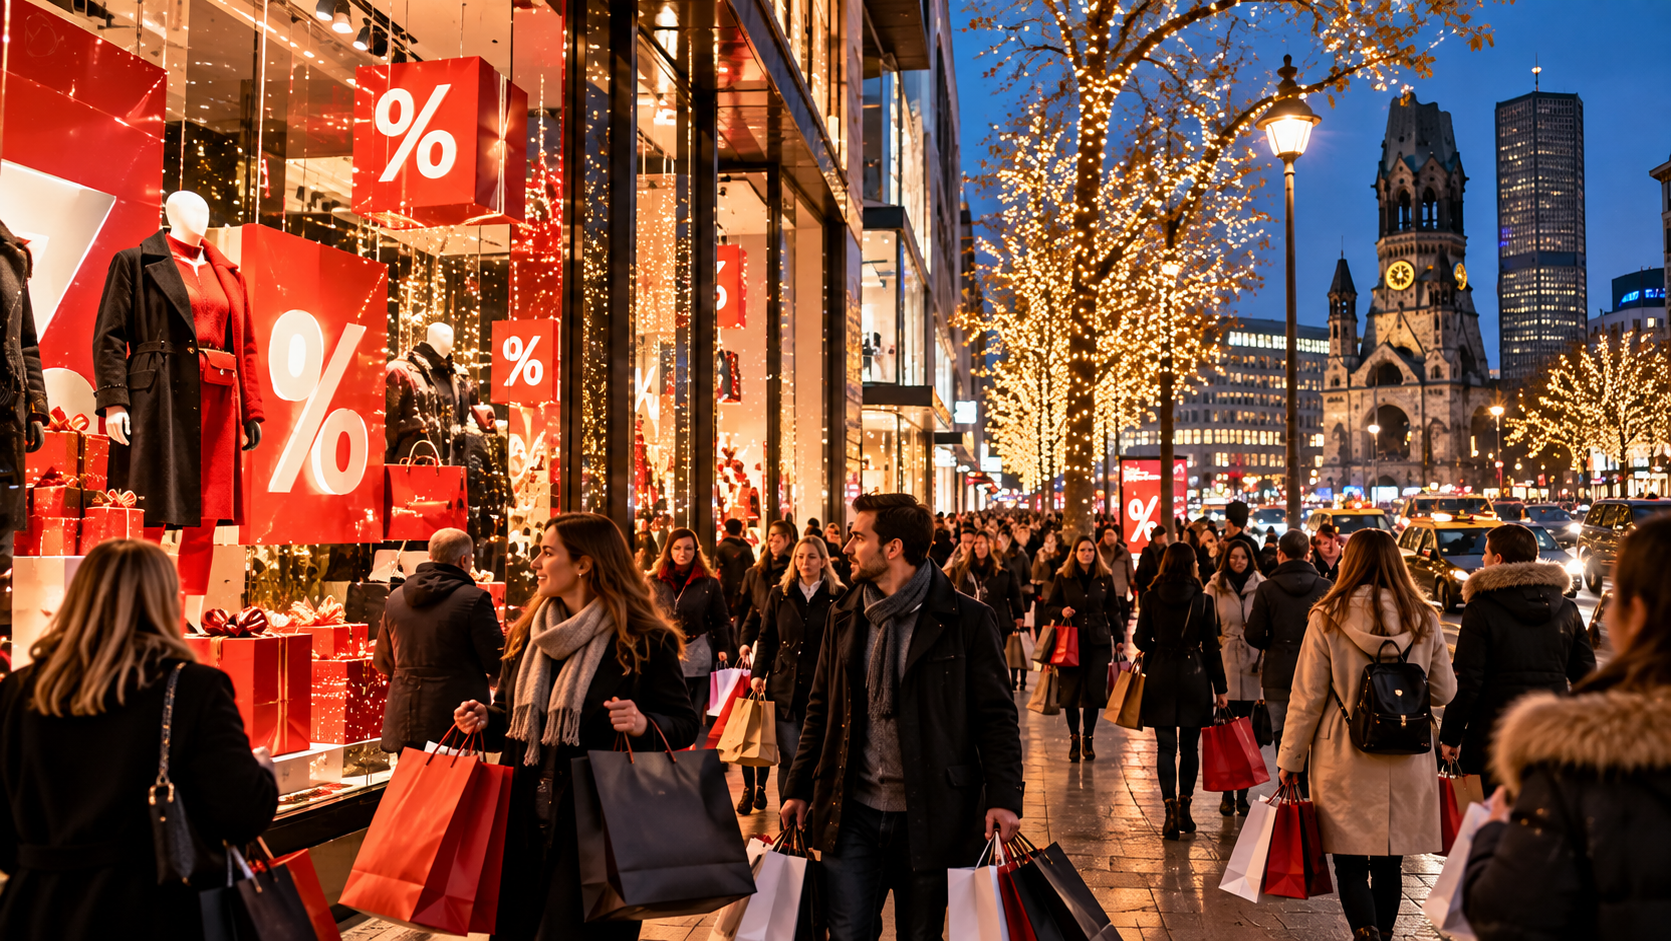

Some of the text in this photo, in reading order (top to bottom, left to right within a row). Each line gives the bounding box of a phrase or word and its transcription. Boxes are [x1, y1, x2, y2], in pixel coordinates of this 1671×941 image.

[374, 83, 457, 183] %
[502, 335, 544, 387] %
[268, 309, 368, 496] %
[1128, 495, 1159, 542] %
